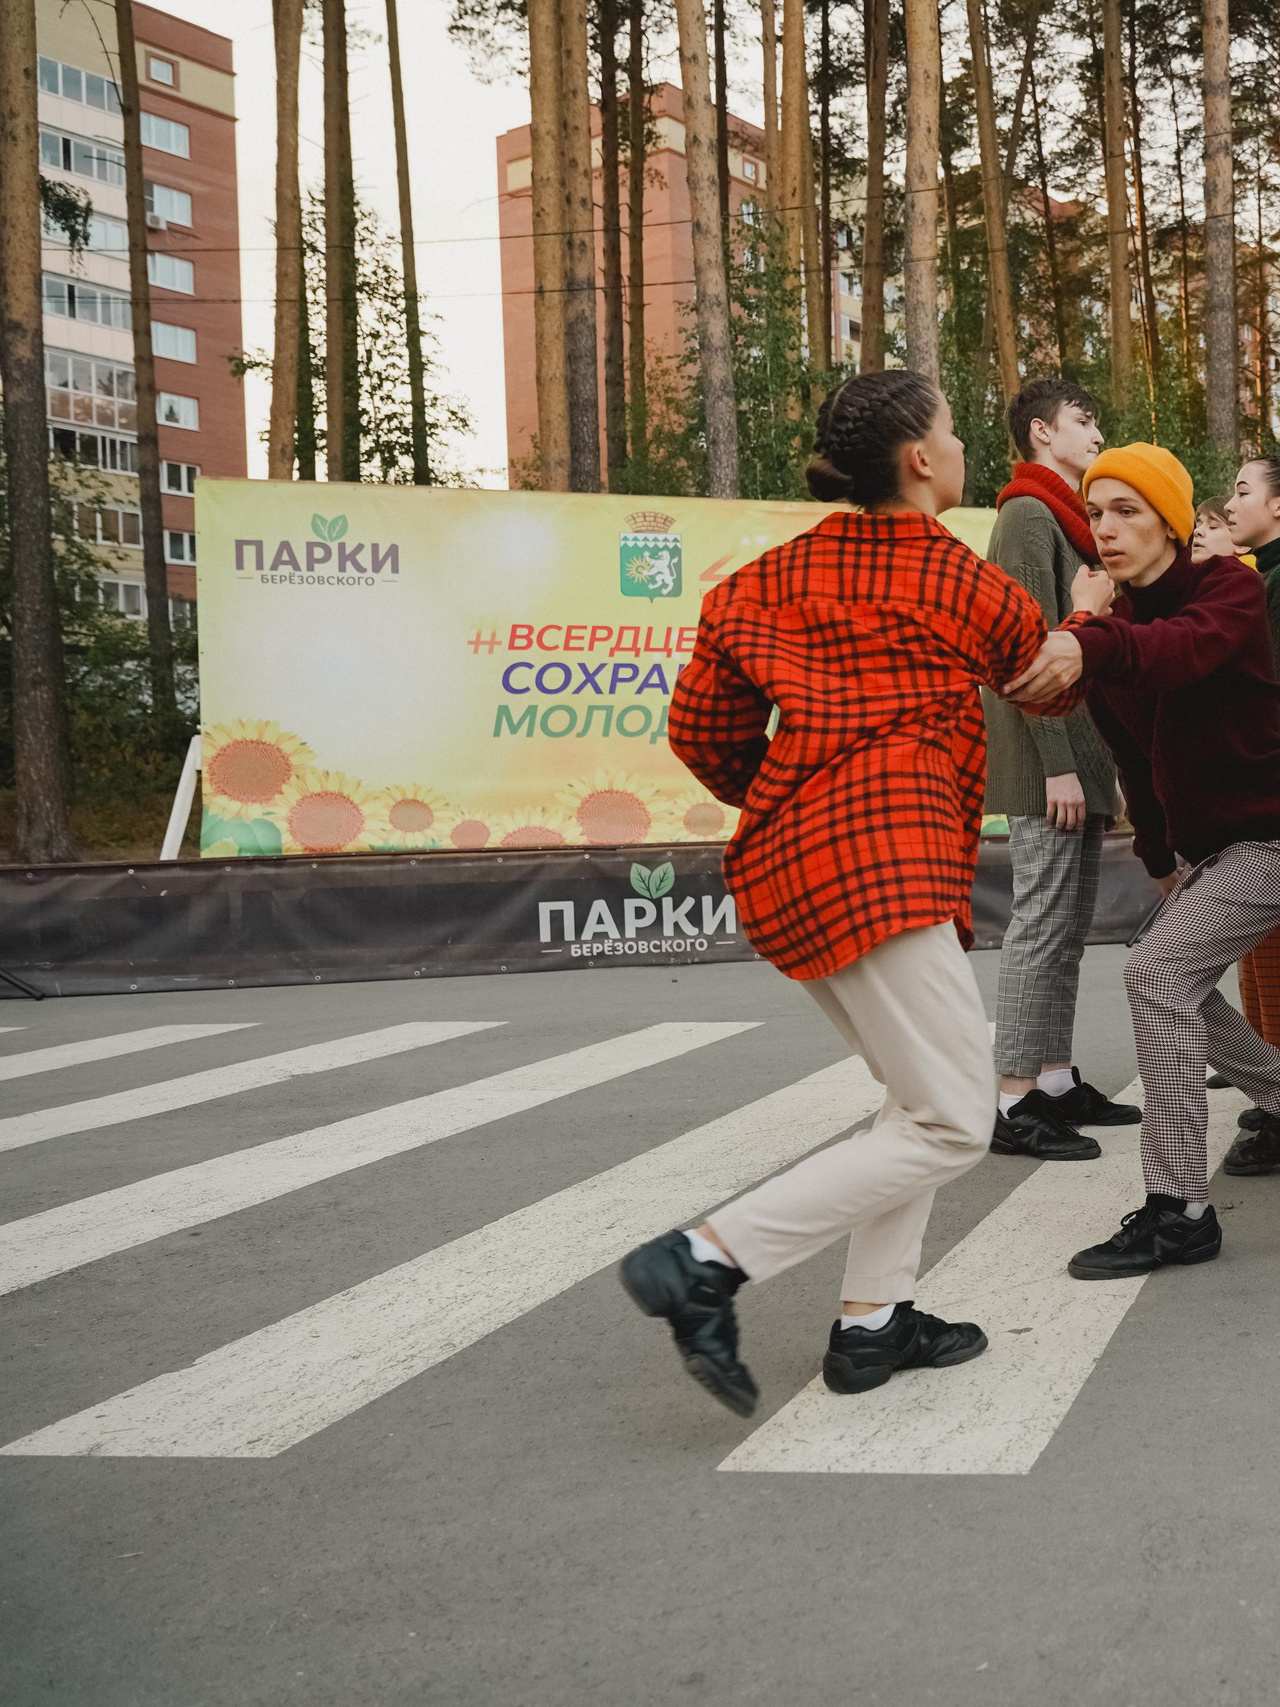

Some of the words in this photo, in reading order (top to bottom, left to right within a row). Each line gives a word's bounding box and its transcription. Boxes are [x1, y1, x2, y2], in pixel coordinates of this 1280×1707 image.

[235, 539, 399, 574] ПАРКИ
[260, 573, 375, 586] БЕРЁЗОВСКОГО
[501, 661, 686, 695] СОХРА
[538, 894, 737, 943] ПАРКИ
[570, 939, 708, 957] БЕРЁЗОВСКОГО
